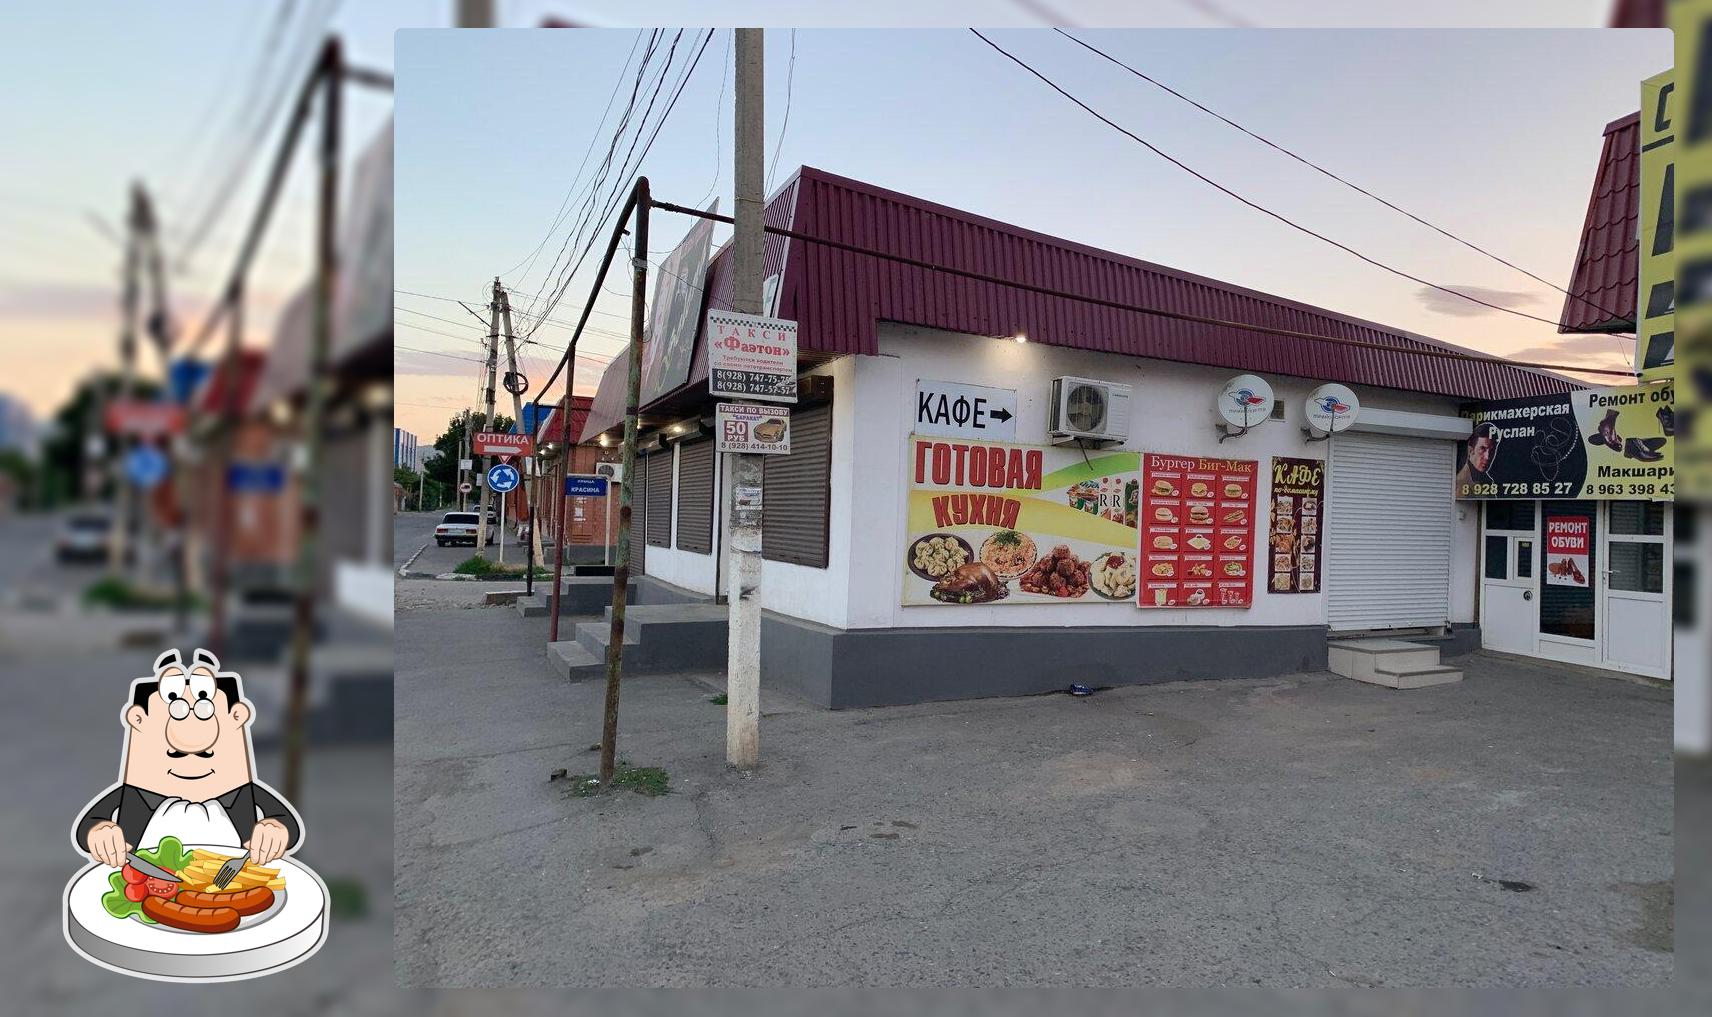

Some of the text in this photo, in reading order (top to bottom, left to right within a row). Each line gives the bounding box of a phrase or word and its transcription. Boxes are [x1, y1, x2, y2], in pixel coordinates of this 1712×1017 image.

[716, 324, 786, 341] ТАКСИ
[717, 370, 746, 382] 8(928)
[717, 381, 747, 392] 8(928)
[1589, 393, 1646, 407] Ремонт
[720, 405, 745, 414] ТАКСИ
[758, 408, 788, 416] ВЫЗОВУ
[917, 391, 987, 428] КАФЕ
[726, 422, 746, 435] 50
[1489, 426, 1536, 440] Руслан
[477, 433, 529, 445] ОПТИКА
[728, 442, 749, 450] (928)
[750, 443, 788, 451] 414-10-10
[915, 440, 1043, 490] ГОТОВАЯ
[1151, 455, 1252, 473] Бургер Биг-Мак
[1274, 463, 1321, 486] КАФЕ
[1462, 482, 1573, 495] 8 928 728 85 27
[1586, 484, 1594, 495] 8
[1598, 484, 1624, 495] 963
[1628, 484, 1655, 495] 398
[931, 493, 1021, 530] КУХНЯ
[1548, 521, 1588, 534] РЕМОНТ
[1551, 536, 1584, 549] ОБУВИ
